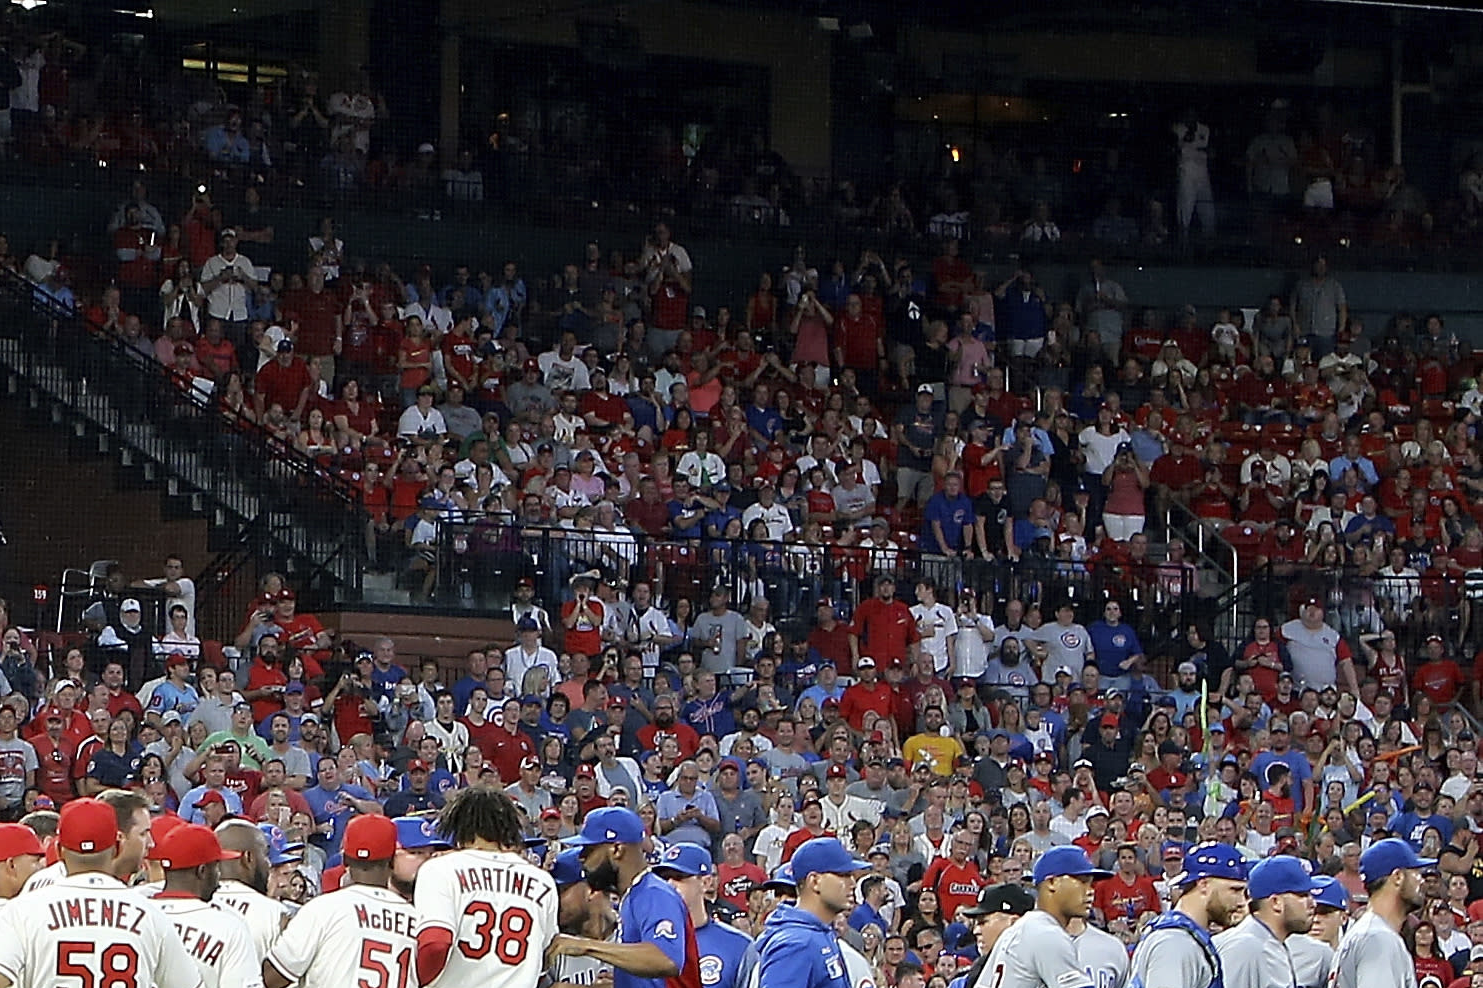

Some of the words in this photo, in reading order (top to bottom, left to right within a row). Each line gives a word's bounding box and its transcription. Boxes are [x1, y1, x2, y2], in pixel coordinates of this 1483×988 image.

[457, 864, 552, 907] MARTÍNEZ
[48, 899, 146, 935] JIMENEZ
[355, 904, 419, 938] McGEE
[458, 901, 533, 966] 38
